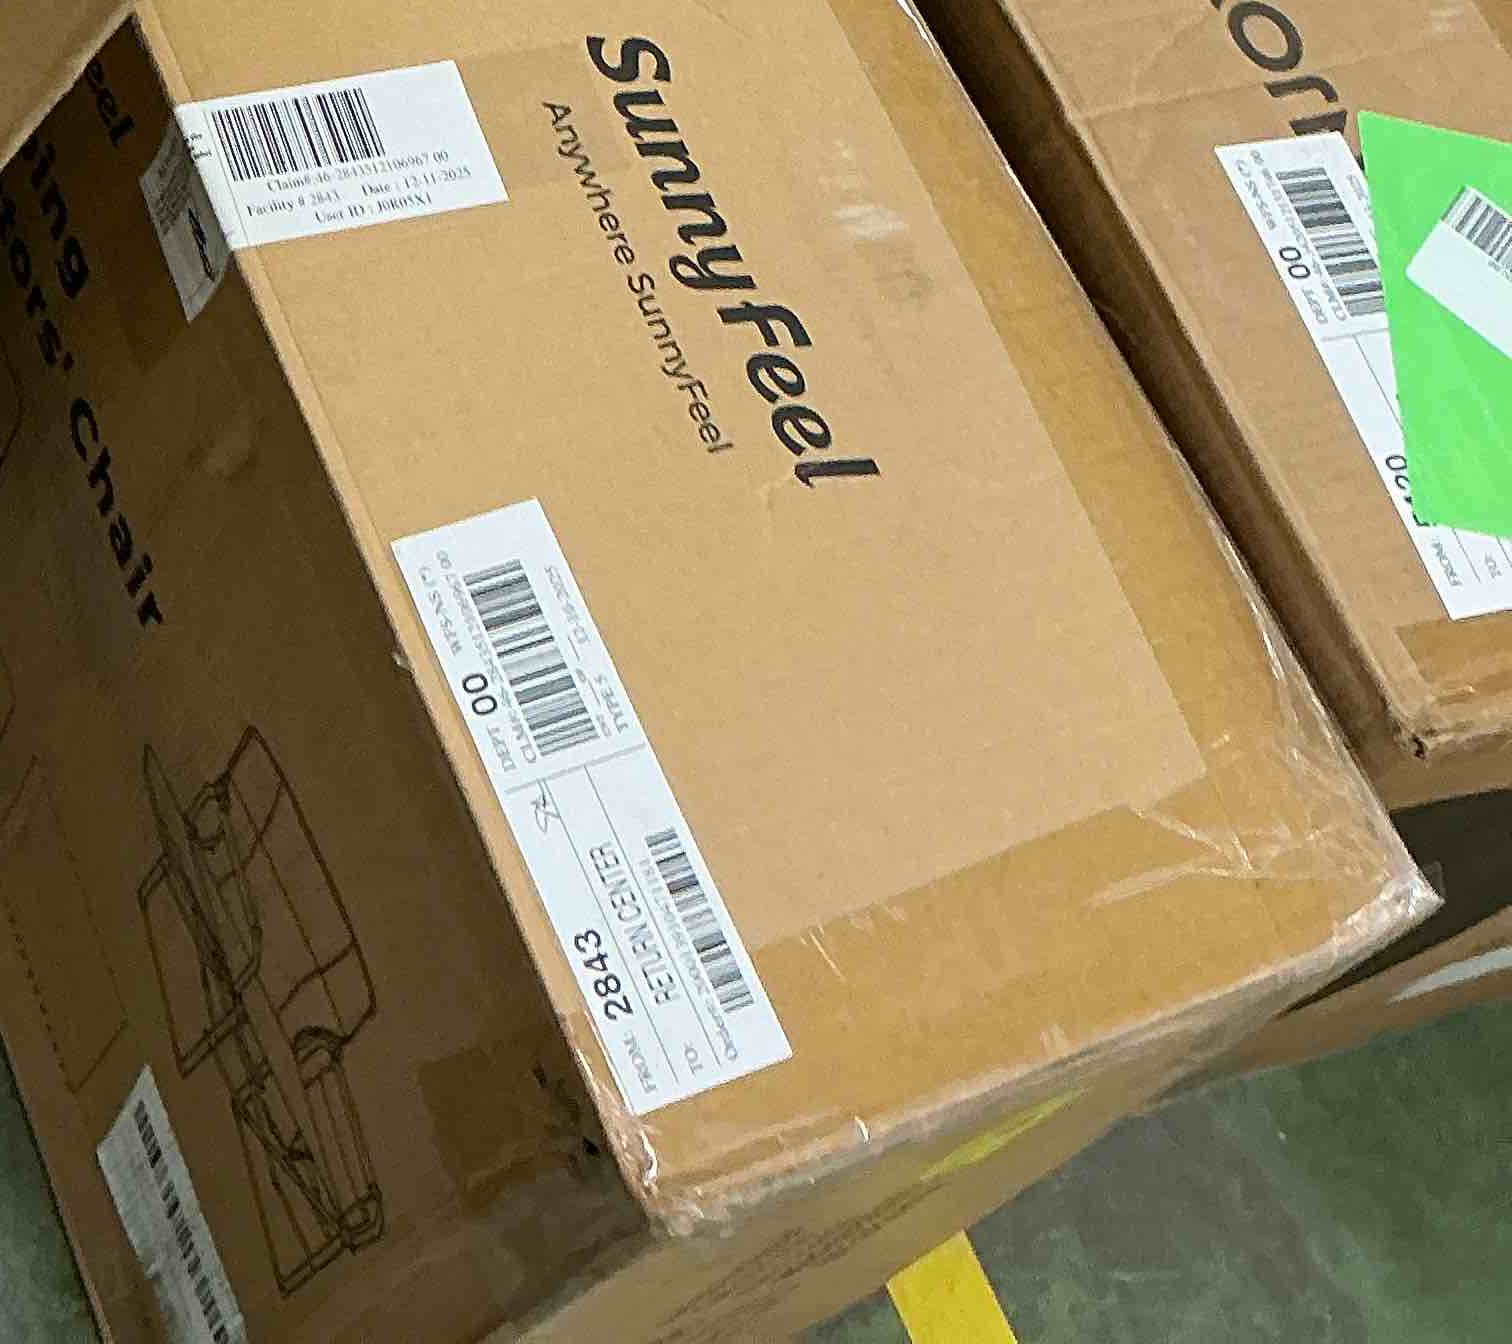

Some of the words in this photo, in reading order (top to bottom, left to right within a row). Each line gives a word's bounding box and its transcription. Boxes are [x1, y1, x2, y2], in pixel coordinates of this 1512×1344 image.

[247, 200, 295, 219] Facility
[360, 180, 392, 198] Date
[542, 99, 636, 266] Anywhere
[627, 271, 735, 455] SunnyFeel
[1277, 241, 1312, 284] 00
[69, 397, 164, 629] Chair
[459, 670, 499, 719] 00
[587, 839, 642, 923] CENTER
[570, 924, 634, 1024] 2843
[622, 919, 681, 1007] RETURN
